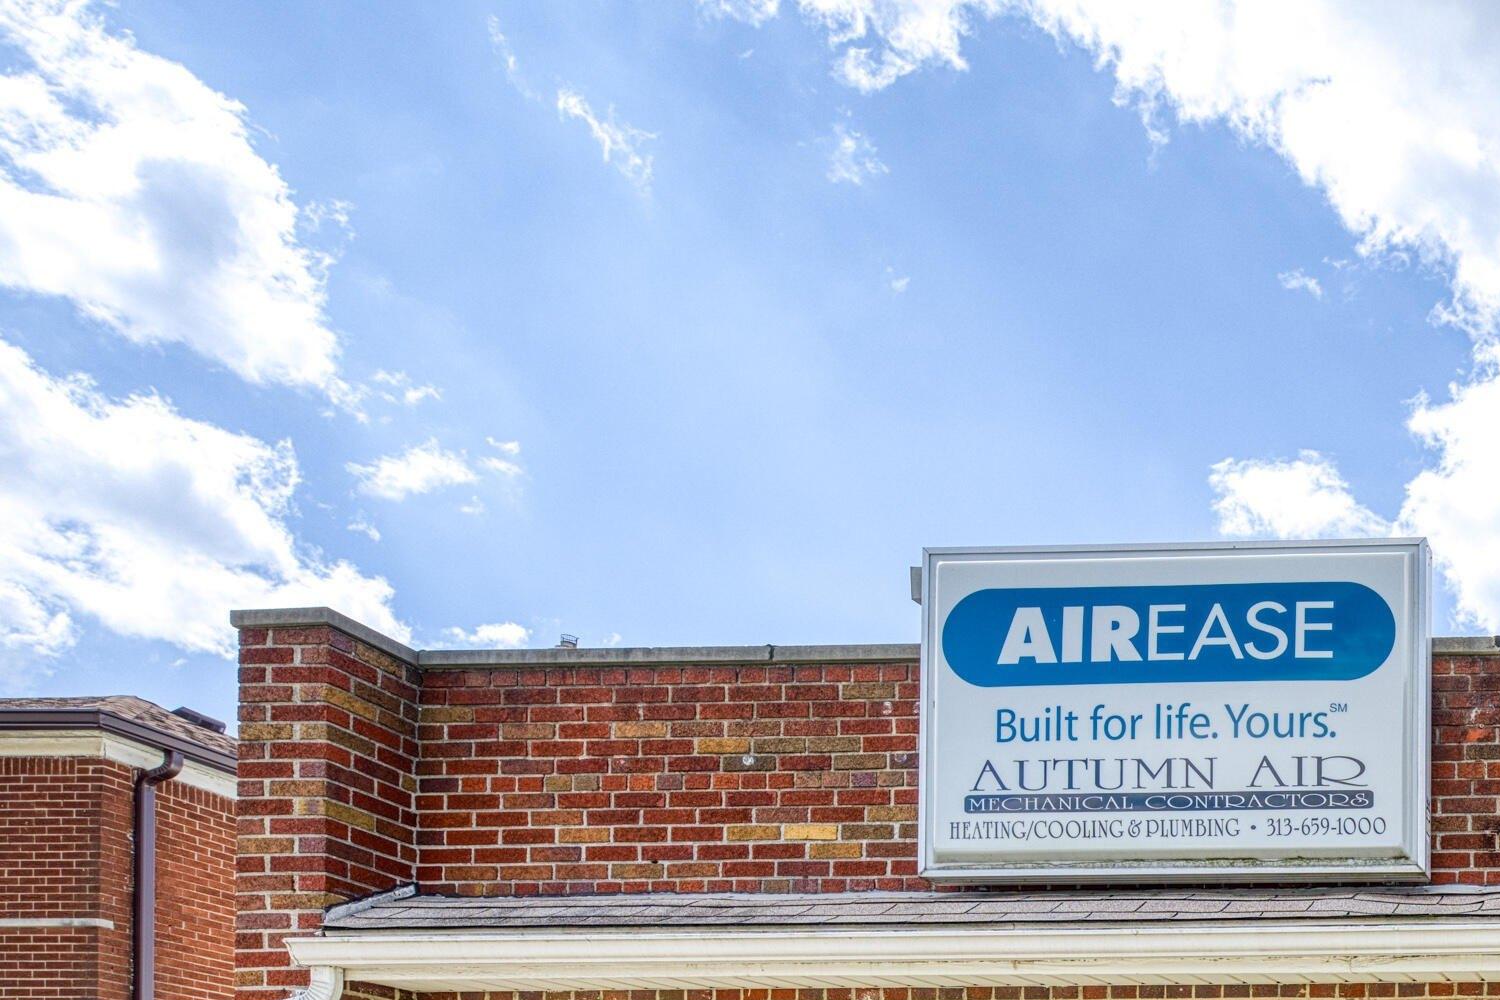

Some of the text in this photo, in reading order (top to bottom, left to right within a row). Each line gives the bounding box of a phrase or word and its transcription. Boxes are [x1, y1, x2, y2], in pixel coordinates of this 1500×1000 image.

[997, 600, 1335, 665] AIREASE
[996, 705, 1078, 743] Built
[1089, 703, 1143, 741] for
[1155, 702, 1218, 740] life.
[969, 755, 1369, 792] AUTUMN AIR
[969, 792, 1369, 811] MECHANICAL CONTRACTORS
[949, 816, 1386, 841] HEATING/COOLING & PLUMBING 313-659-1000
